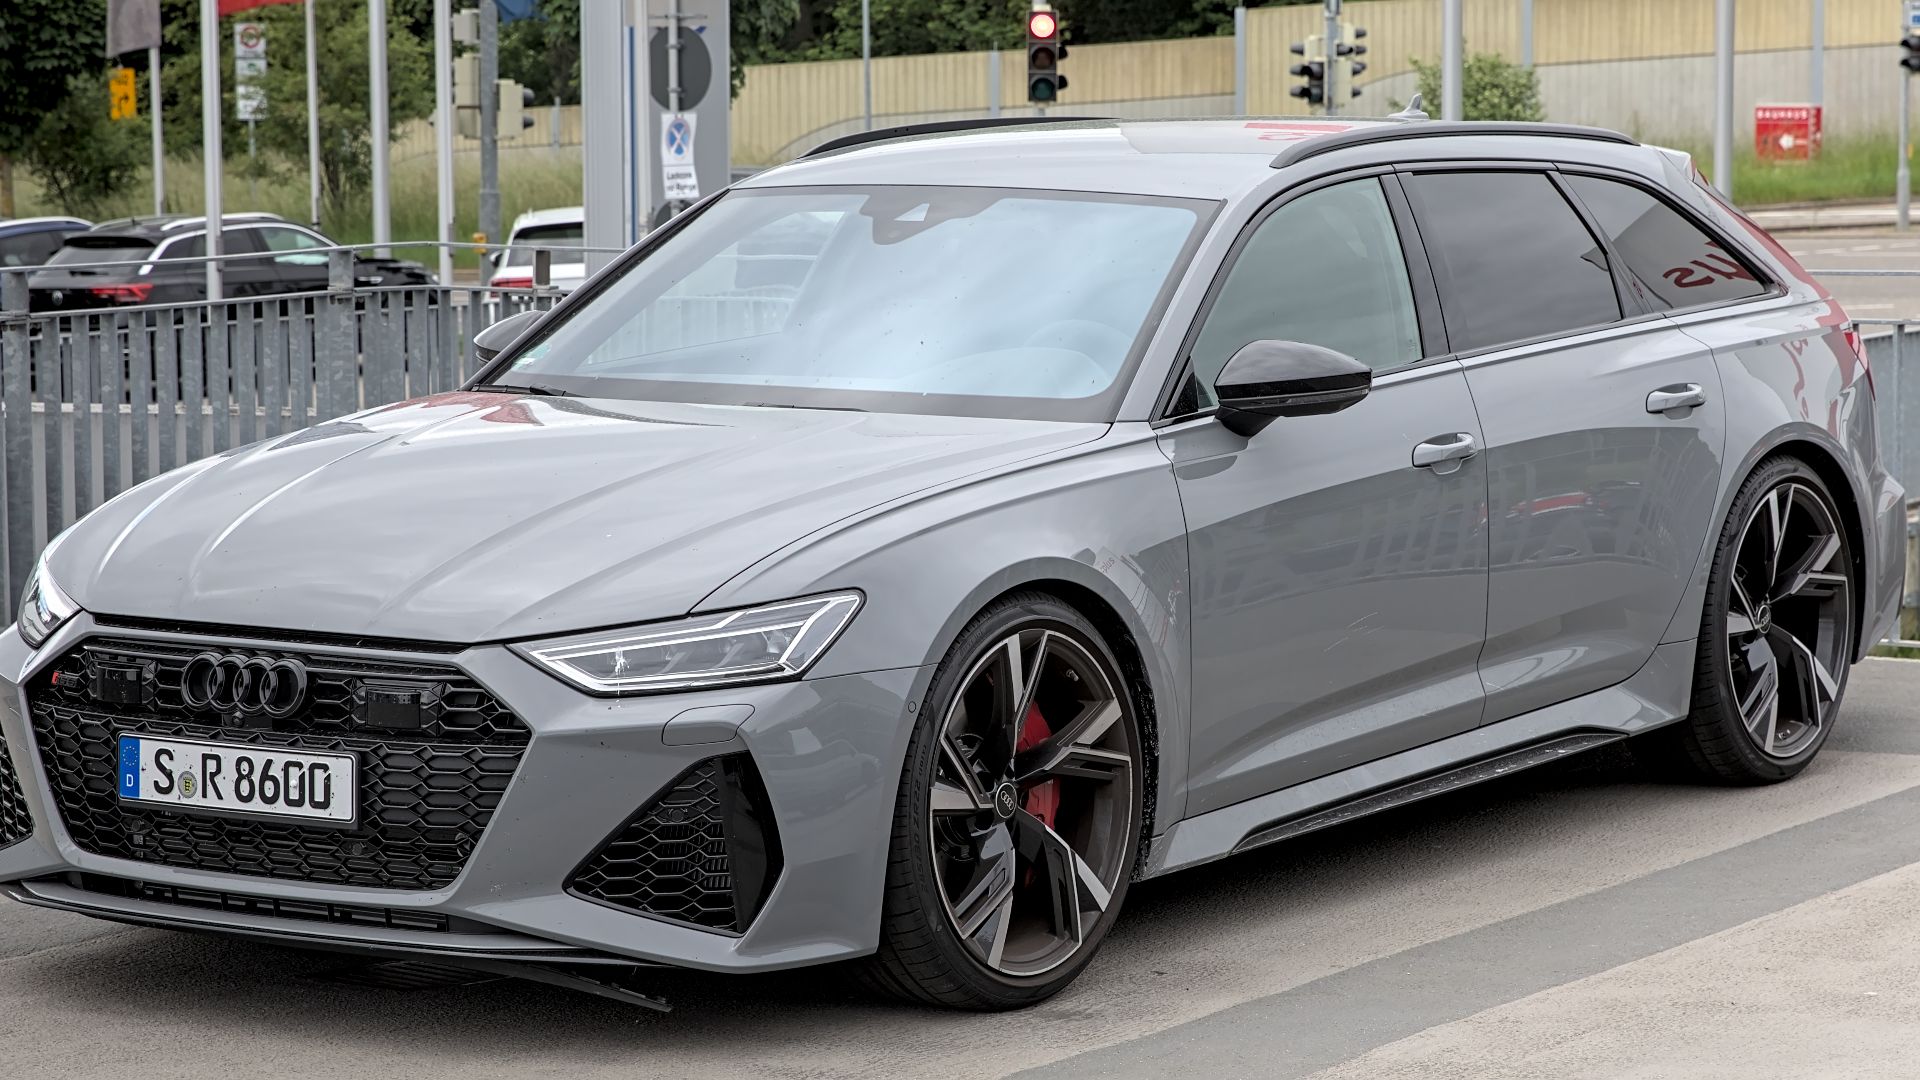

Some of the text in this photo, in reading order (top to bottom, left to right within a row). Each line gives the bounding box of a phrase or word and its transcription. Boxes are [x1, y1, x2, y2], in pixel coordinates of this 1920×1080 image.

[126, 774, 134, 787] D
[153, 748, 332, 810] S R 8600
